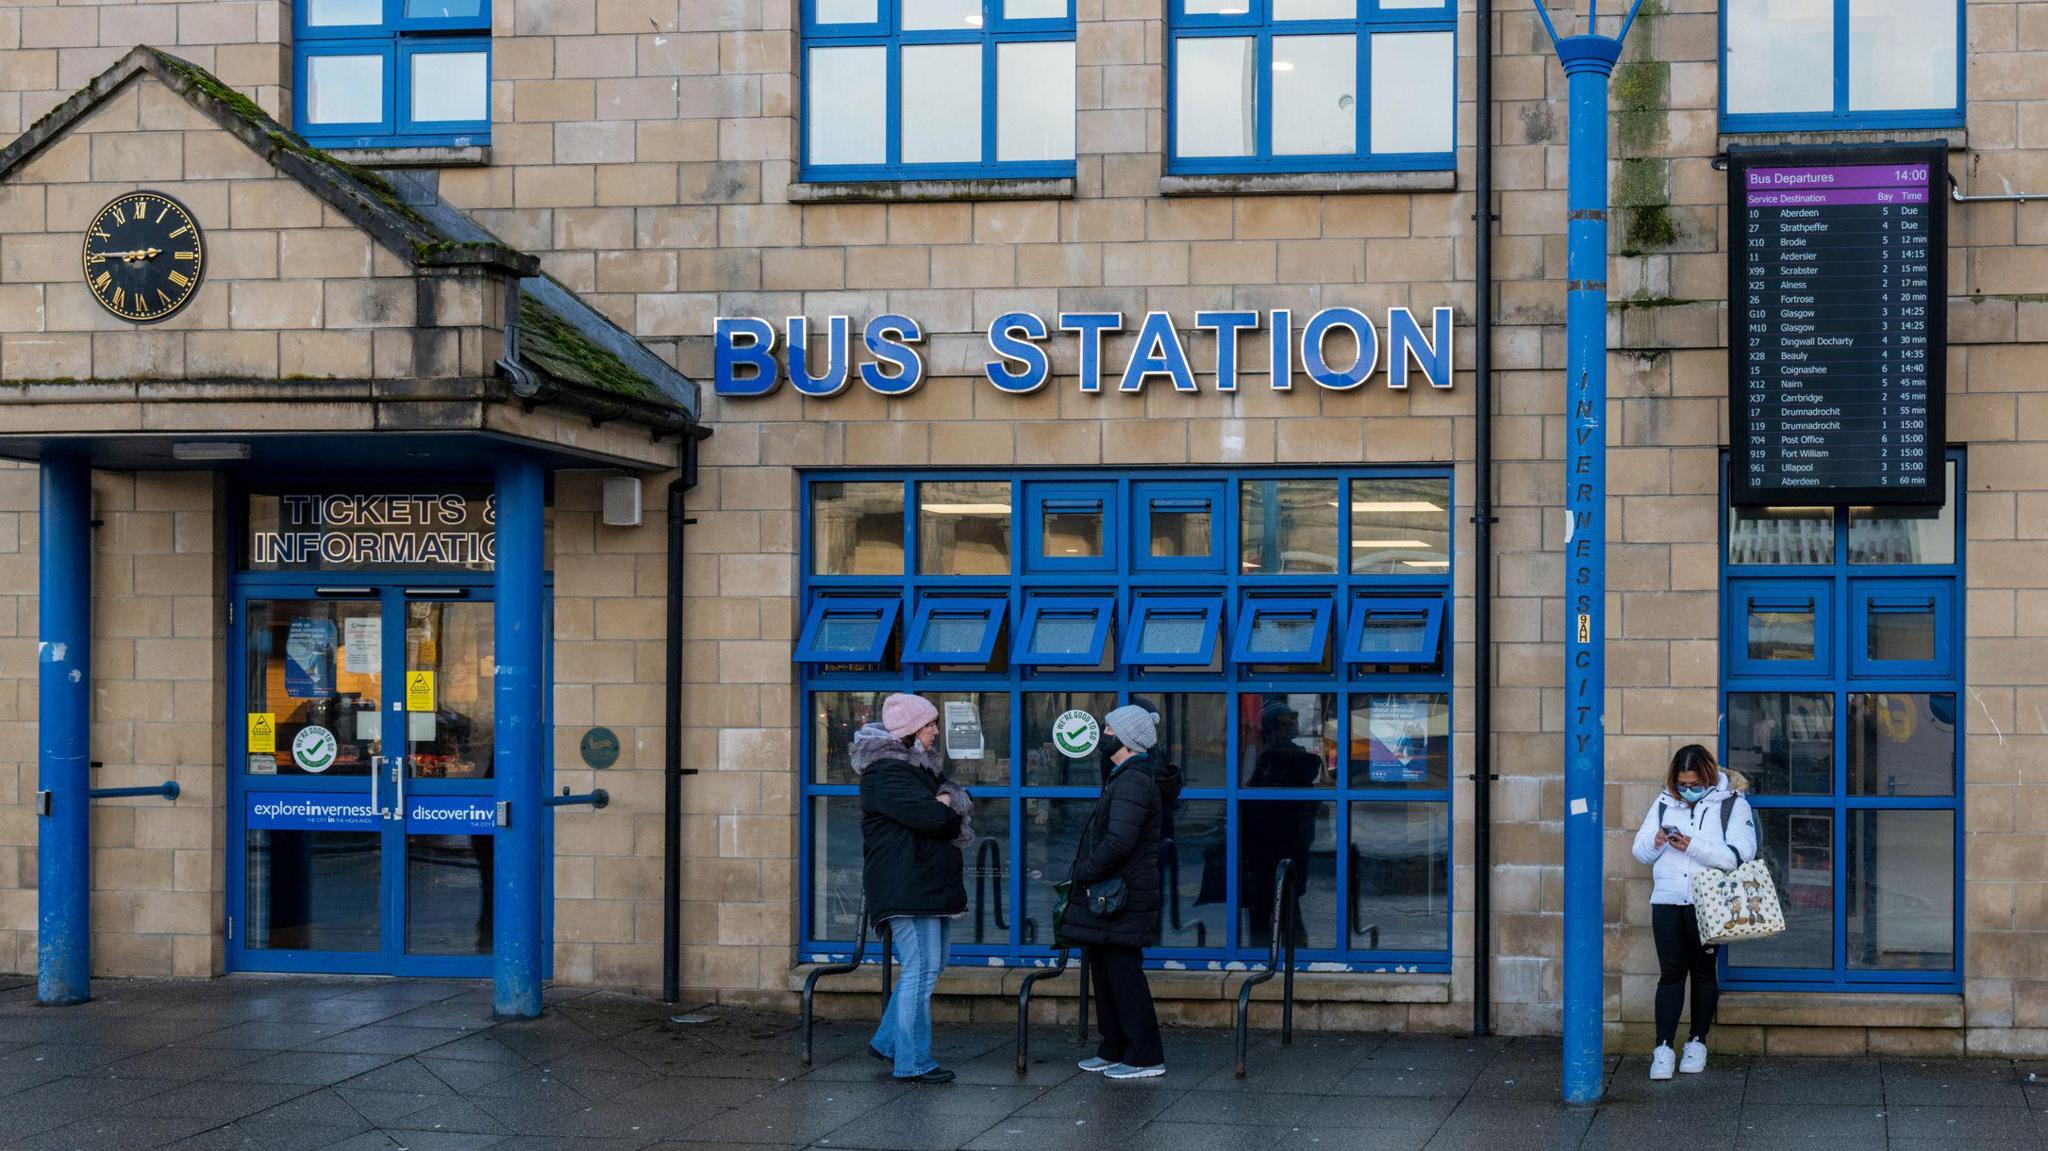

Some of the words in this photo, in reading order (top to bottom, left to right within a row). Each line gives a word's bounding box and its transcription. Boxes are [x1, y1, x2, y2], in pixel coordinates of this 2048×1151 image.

[1751, 173, 1771, 184] Bus
[1775, 173, 1834, 185] Departures
[1895, 169, 1927, 181] 14:00
[1749, 195, 1777, 204] Service
[1780, 194, 1826, 203] Destination
[1878, 193, 1893, 202] Bay
[1902, 192, 1922, 200] Time
[1780, 209, 1819, 217] Aberdeen
[1902, 207, 1918, 215] Due
[1749, 224, 1759, 232] 27
[1780, 224, 1828, 233] Strathpeffer
[1781, 238, 1806, 246] Brodie
[1882, 236, 1888, 244] 5
[1902, 236, 1911, 244] 12
[1913, 236, 1927, 244] min
[1750, 253, 1759, 261] 11
[1902, 250, 1925, 258] 14:15
[1882, 265, 1888, 273] 2
[1781, 281, 1807, 289] Alness
[1902, 279, 1911, 287] 17
[1913, 279, 1927, 287] min
[1749, 296, 1760, 304] 26
[1901, 293, 1911, 301] 20
[1913, 293, 1927, 301] min
[1749, 310, 1766, 318] G10
[1781, 310, 1815, 319] Glasgow
[1902, 307, 1925, 315] 14:25
[1750, 324, 1766, 332] M10
[1781, 324, 1815, 333] Glasgow
[1882, 322, 1888, 330] 3
[1750, 338, 1760, 346] 27
[1781, 338, 1815, 347] Dingwall
[1901, 336, 1910, 344] 30
[1912, 336, 1926, 344] min
[713, 313, 923, 396] BUS
[986, 306, 1455, 393] STATION
[1750, 352, 1765, 360] X28
[1781, 352, 1808, 361] Beauly
[1901, 350, 1924, 358] 14:35
[1781, 380, 1802, 388] Nairn
[1882, 379, 1888, 387] 5
[1781, 394, 1823, 403] Carrbridge
[1882, 393, 1888, 401] 2
[1782, 408, 1840, 416] Drumnadrochit
[1882, 407, 1888, 415] 1
[1901, 407, 1910, 415] 55
[1912, 407, 1926, 415] min
[1882, 421, 1888, 429] 1
[1882, 435, 1887, 443] 6
[1751, 450, 1765, 458] 919
[1782, 450, 1798, 458] Fort
[1800, 450, 1829, 458] William
[1882, 449, 1887, 457] 2
[1782, 464, 1814, 473] Ullapool
[1882, 463, 1887, 471] 3
[1751, 478, 1761, 486] 10
[1899, 476, 1909, 484] 60
[1912, 476, 1926, 484] min
[1576, 372, 1592, 614] INVERNESS
[284, 494, 467, 525] TICKETS
[254, 532, 495, 563] INFORMATI
[1576, 651, 1591, 752] CITY
[1057, 713, 1073, 729] WE'RE
[1074, 711, 1091, 722] GOOD
[309, 726, 325, 735] GOOD
[254, 800, 372, 819] exploreinverness
[412, 805, 495, 821] discoverinv
[328, 815, 335, 823] in
